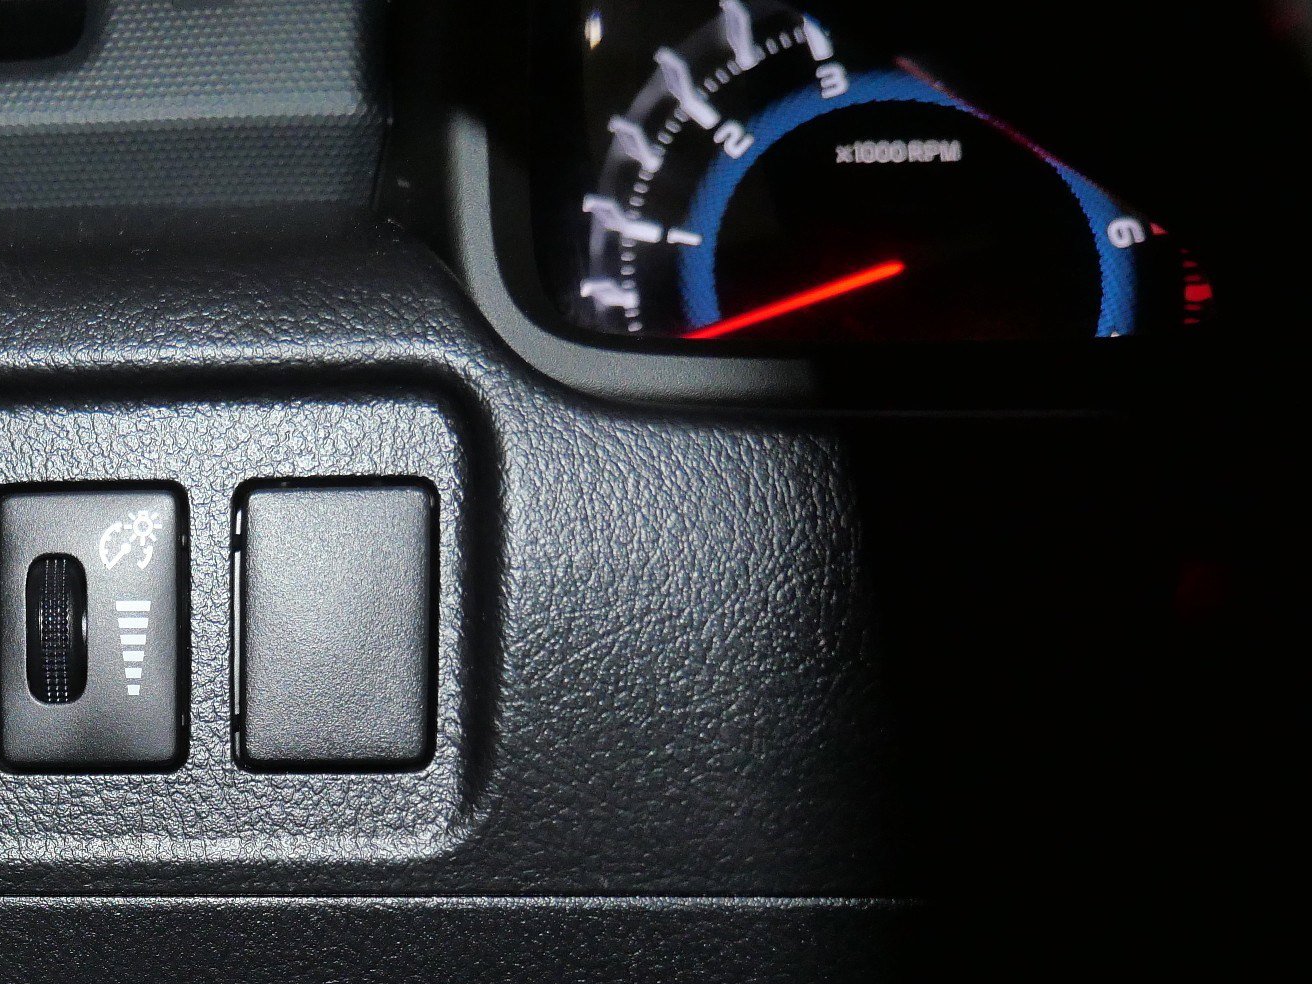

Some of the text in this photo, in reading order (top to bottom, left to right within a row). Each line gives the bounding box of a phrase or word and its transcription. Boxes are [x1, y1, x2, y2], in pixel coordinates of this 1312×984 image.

[815, 64, 850, 99] 3
[713, 122, 755, 159] 2
[836, 140, 962, 163] x1000 RPM
[1107, 217, 1146, 249] 6
